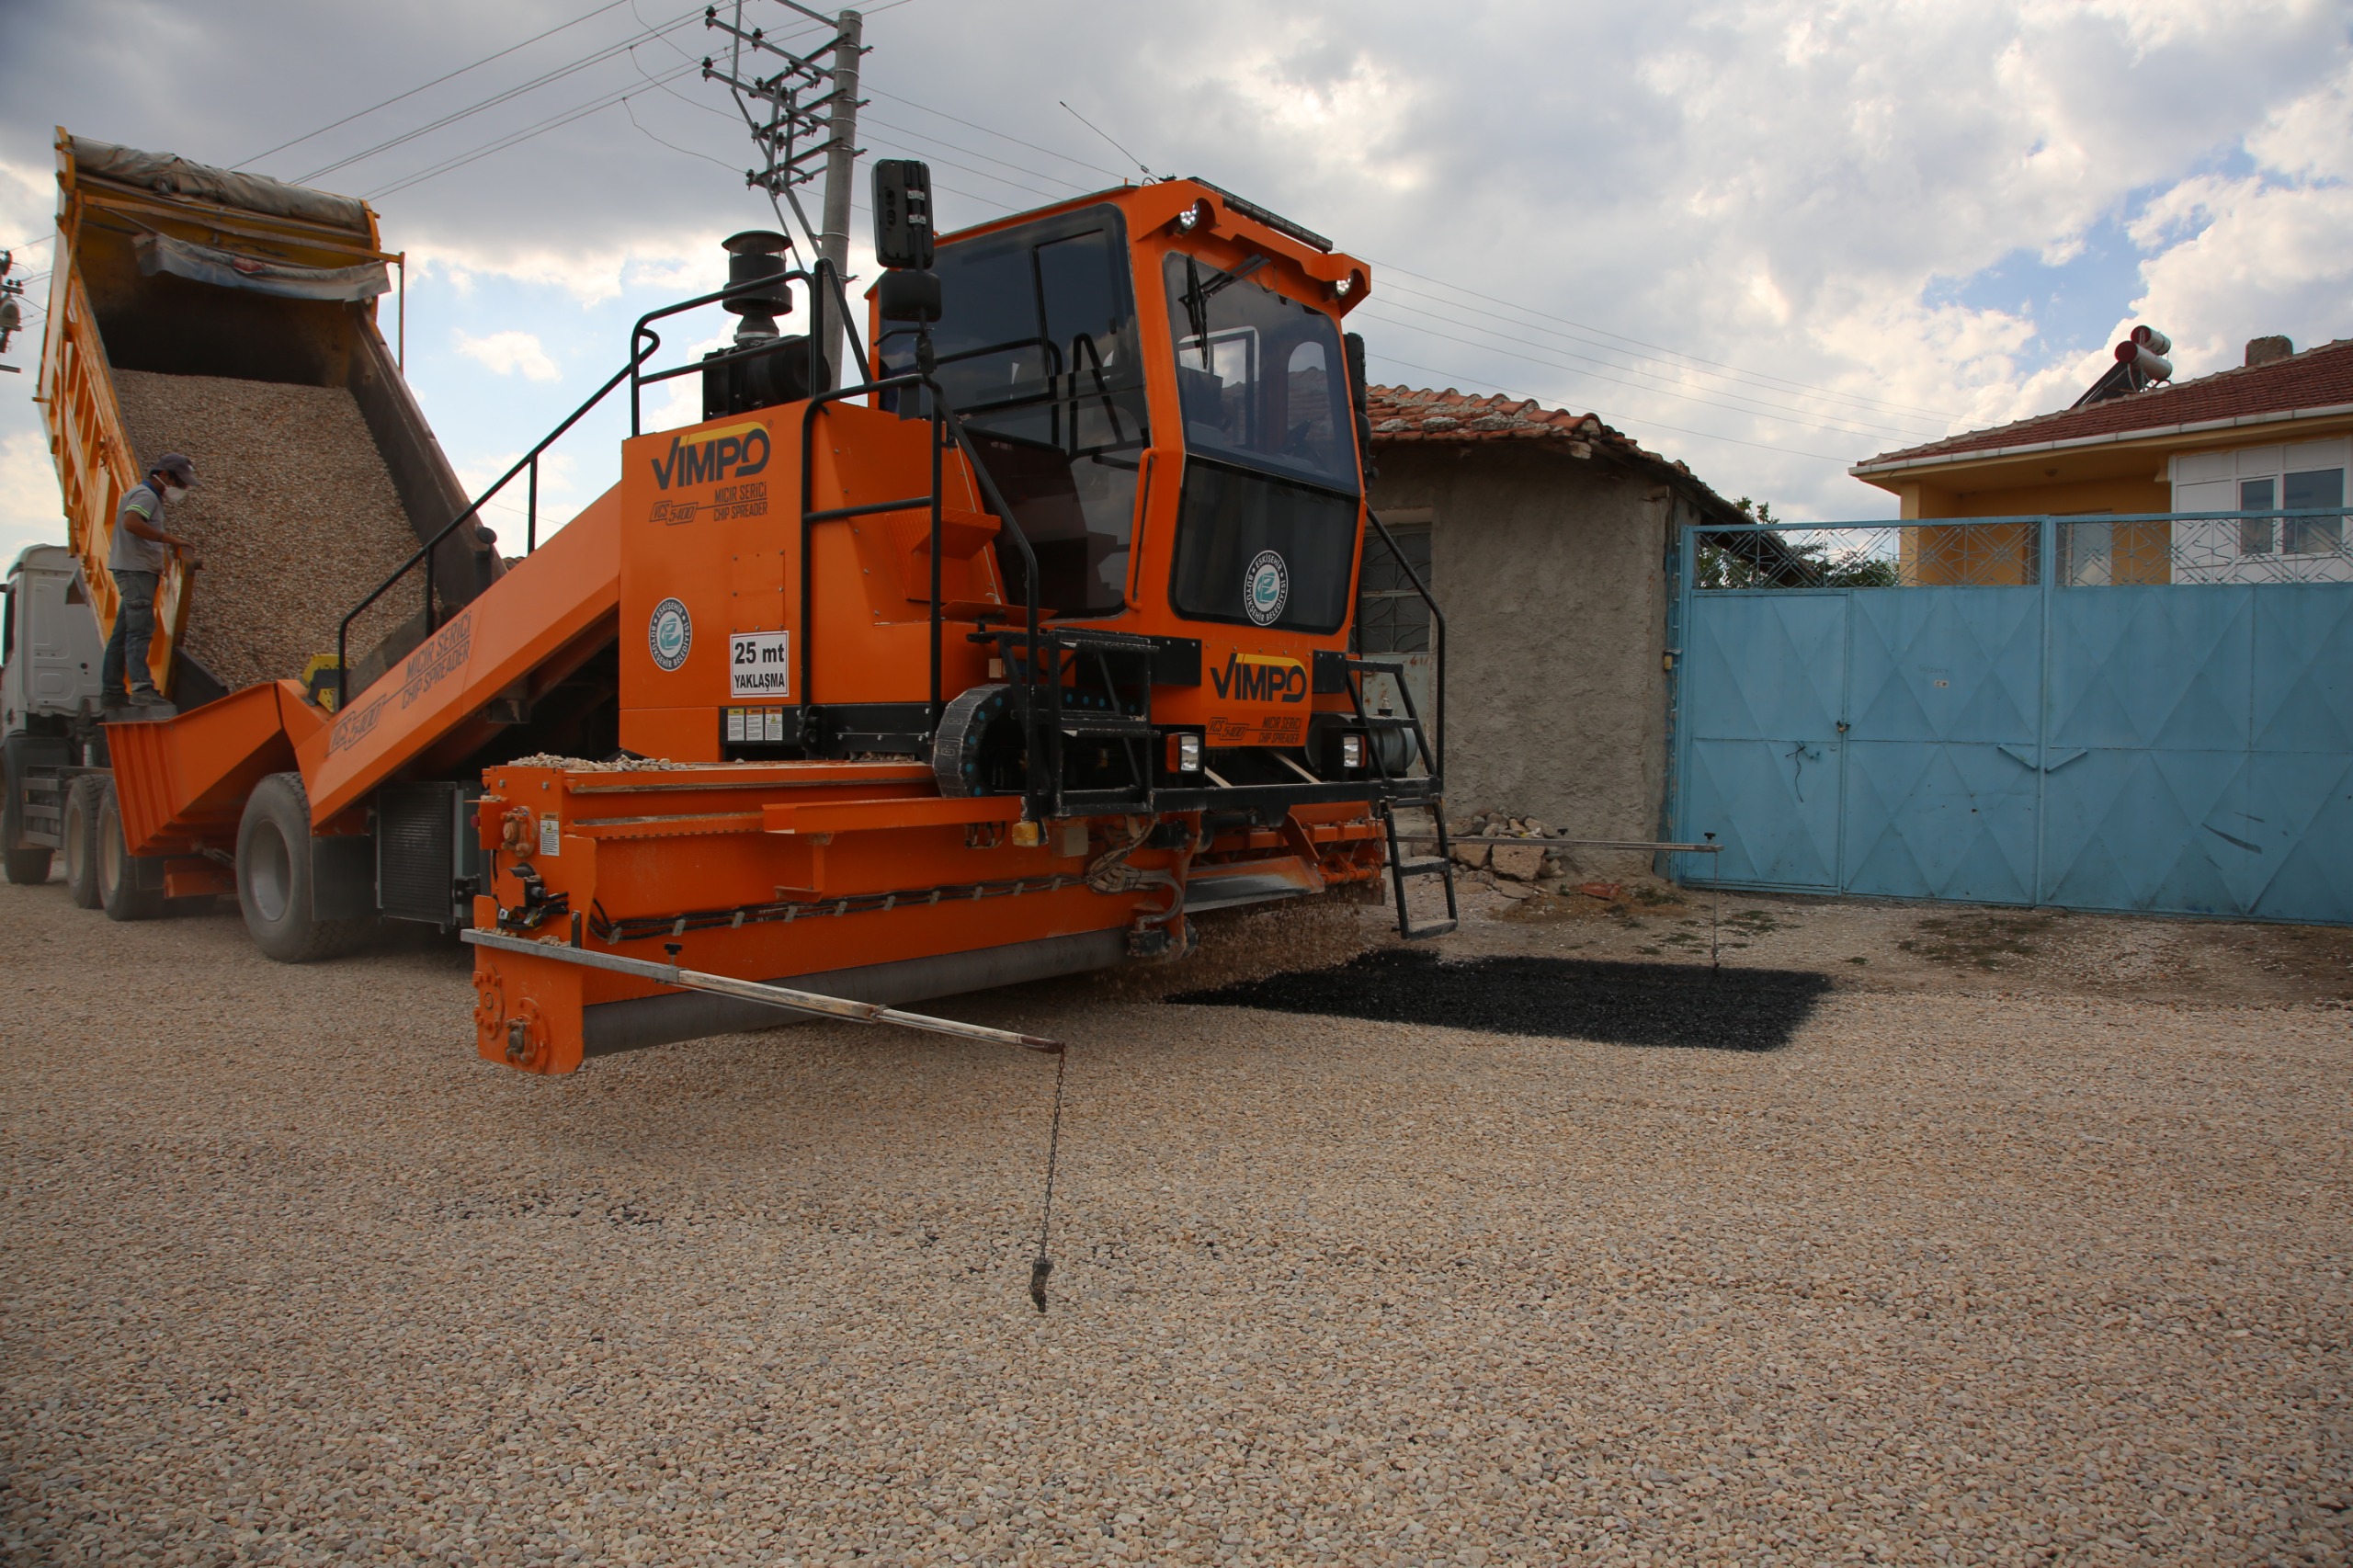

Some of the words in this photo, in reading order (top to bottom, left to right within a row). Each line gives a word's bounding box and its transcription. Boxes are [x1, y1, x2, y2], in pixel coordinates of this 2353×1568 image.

[651, 426, 770, 490] VIMPO
[654, 503, 670, 518] VCS
[669, 506, 695, 522] 5400
[714, 507, 730, 521] CHIP
[731, 501, 767, 519] SPREADER
[1256, 553, 1282, 571] ESKİŞEHİR
[656, 602, 684, 619] ESKİŞEHİR
[734, 642, 756, 664] 25
[762, 643, 785, 663] mt
[424, 640, 470, 693] SPREADER
[734, 673, 785, 691] YAKLAŞMA
[1210, 653, 1307, 703] VIMPO
[1222, 726, 1246, 737] 5400
